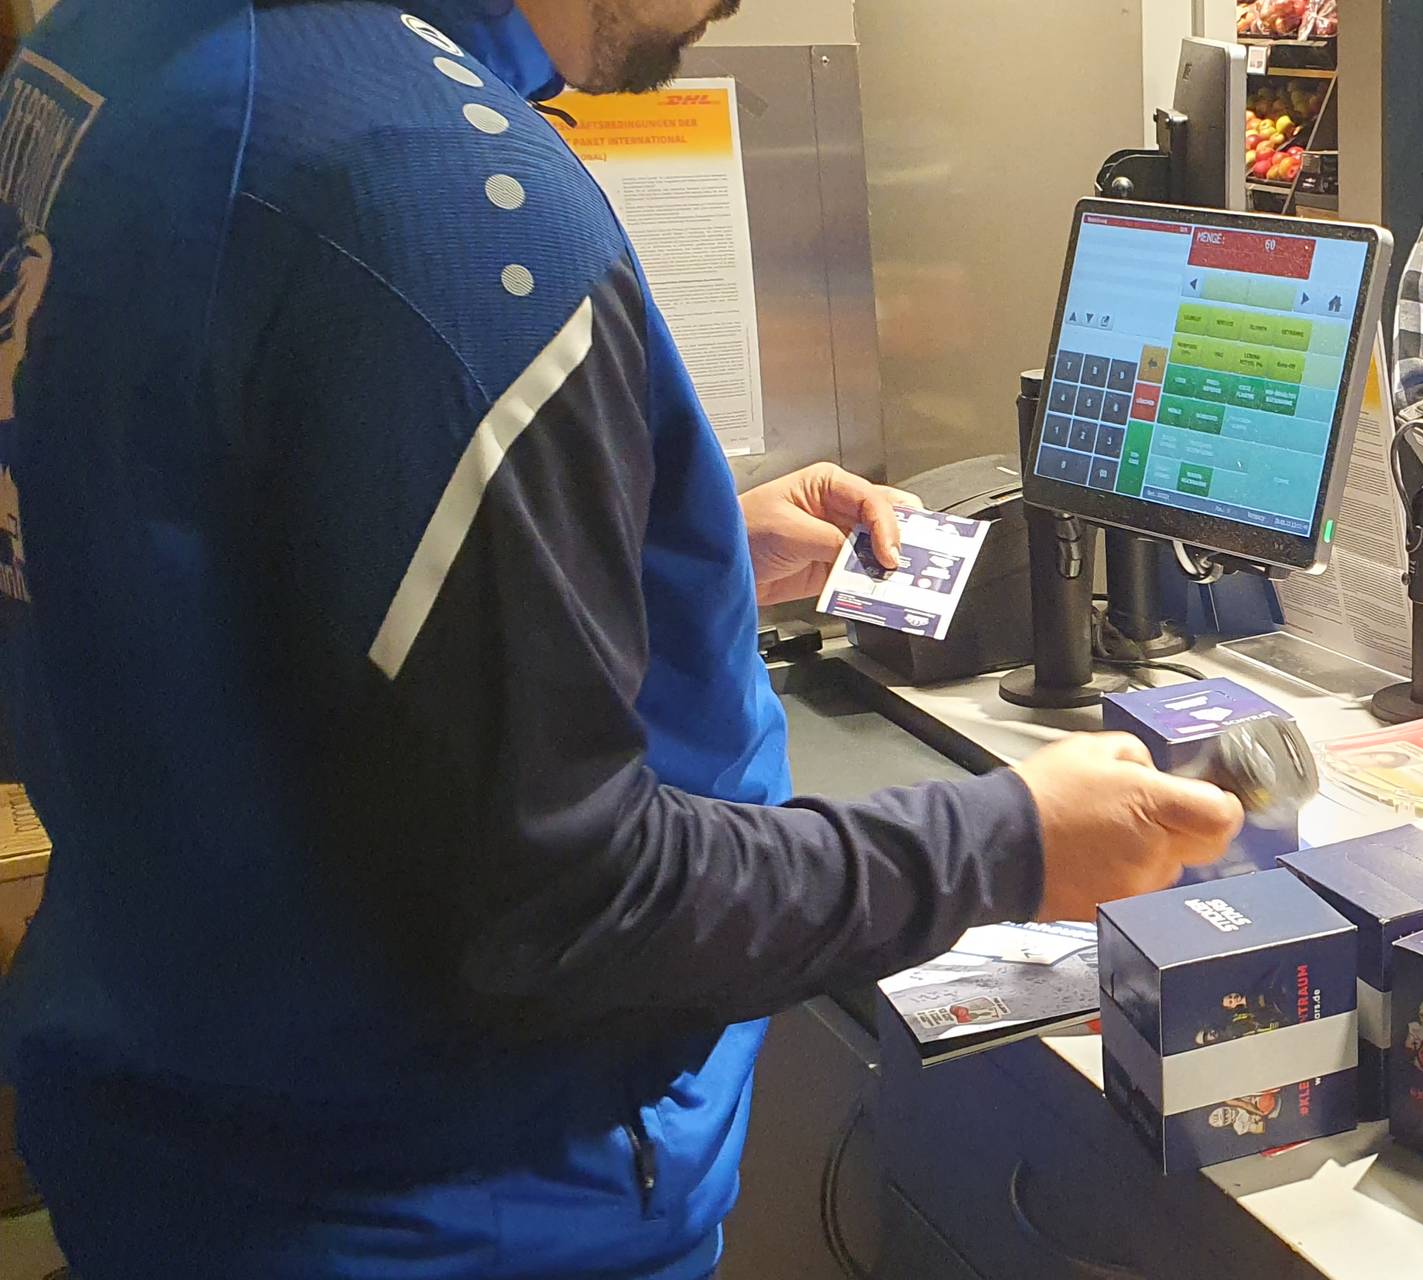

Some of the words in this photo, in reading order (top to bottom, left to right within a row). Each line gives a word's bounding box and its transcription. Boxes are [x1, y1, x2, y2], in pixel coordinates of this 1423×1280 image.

[665, 94, 712, 106] DHL
[607, 135, 688, 146] INTERNATIONAL
[1196, 231, 1225, 245] MENGE:
